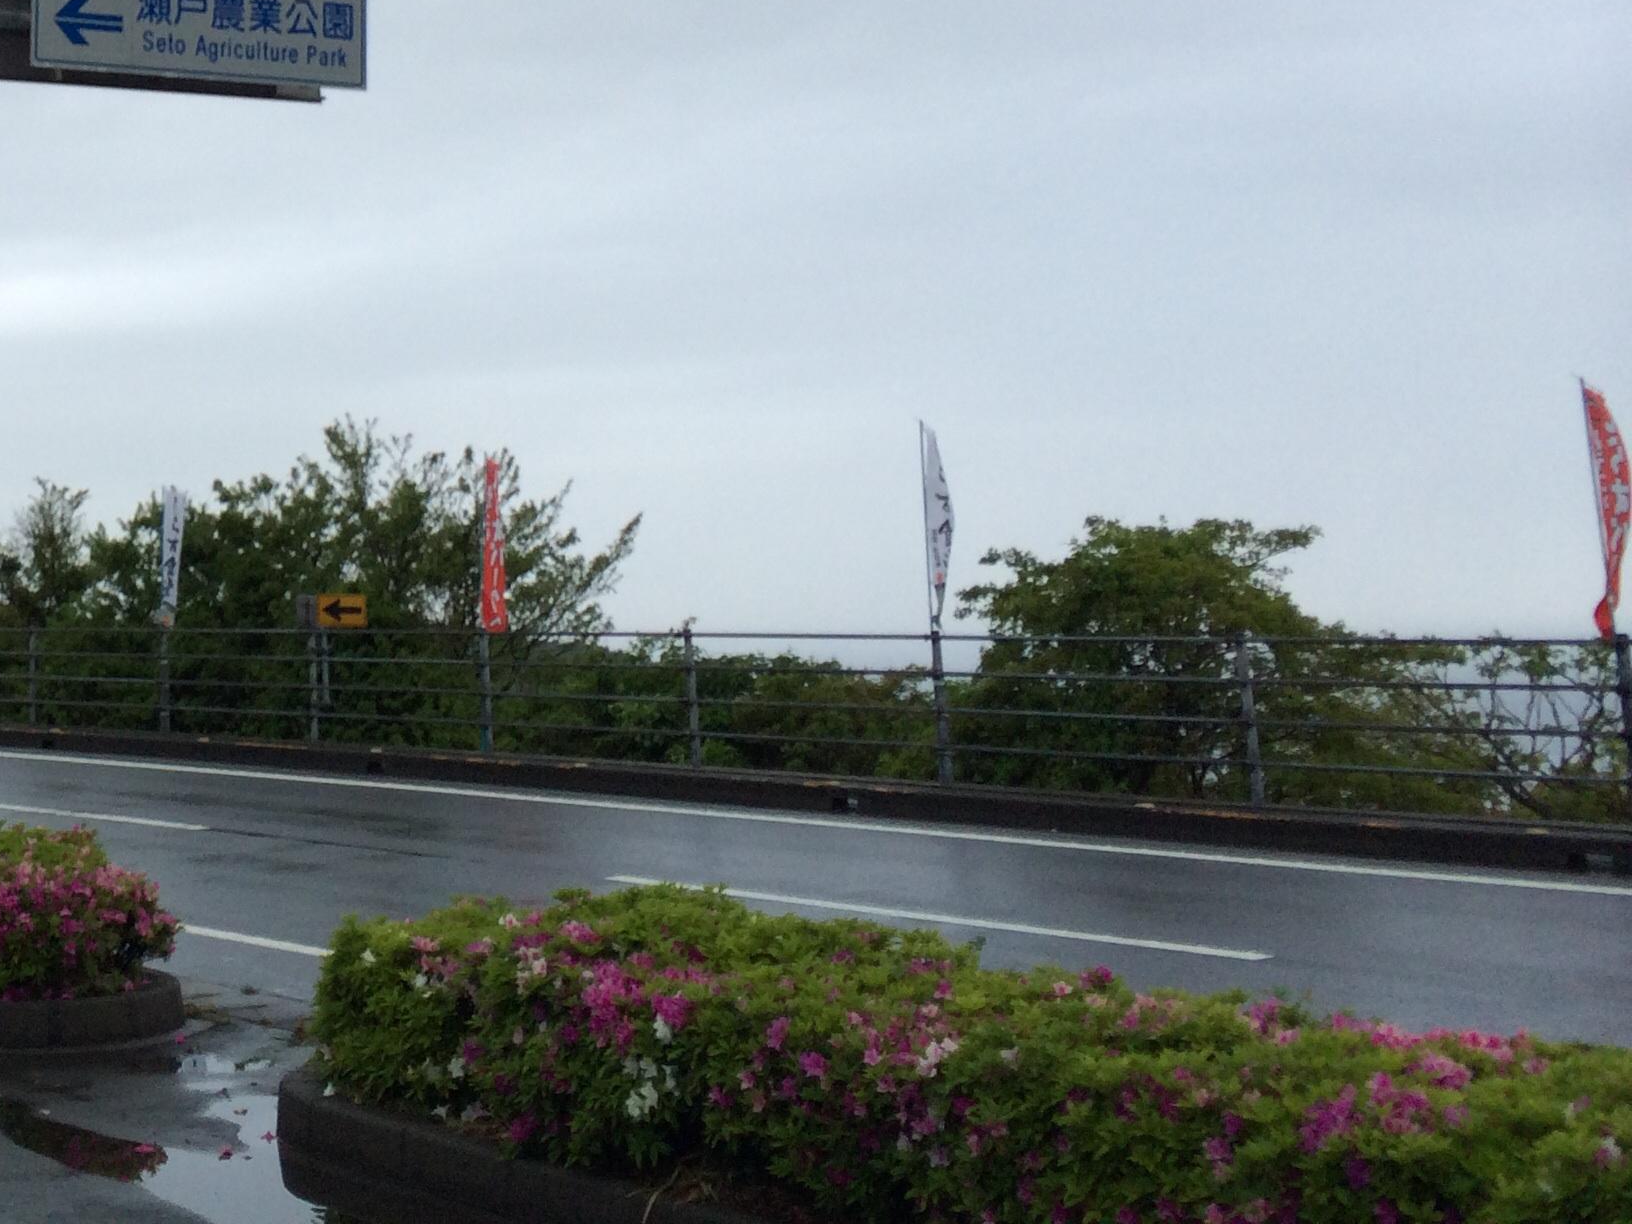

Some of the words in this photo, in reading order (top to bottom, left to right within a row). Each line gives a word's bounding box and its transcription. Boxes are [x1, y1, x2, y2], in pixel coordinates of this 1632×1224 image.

[142, 31, 187, 56] Seto
[195, 35, 299, 64] Agriculture
[306, 45, 348, 68] Park
